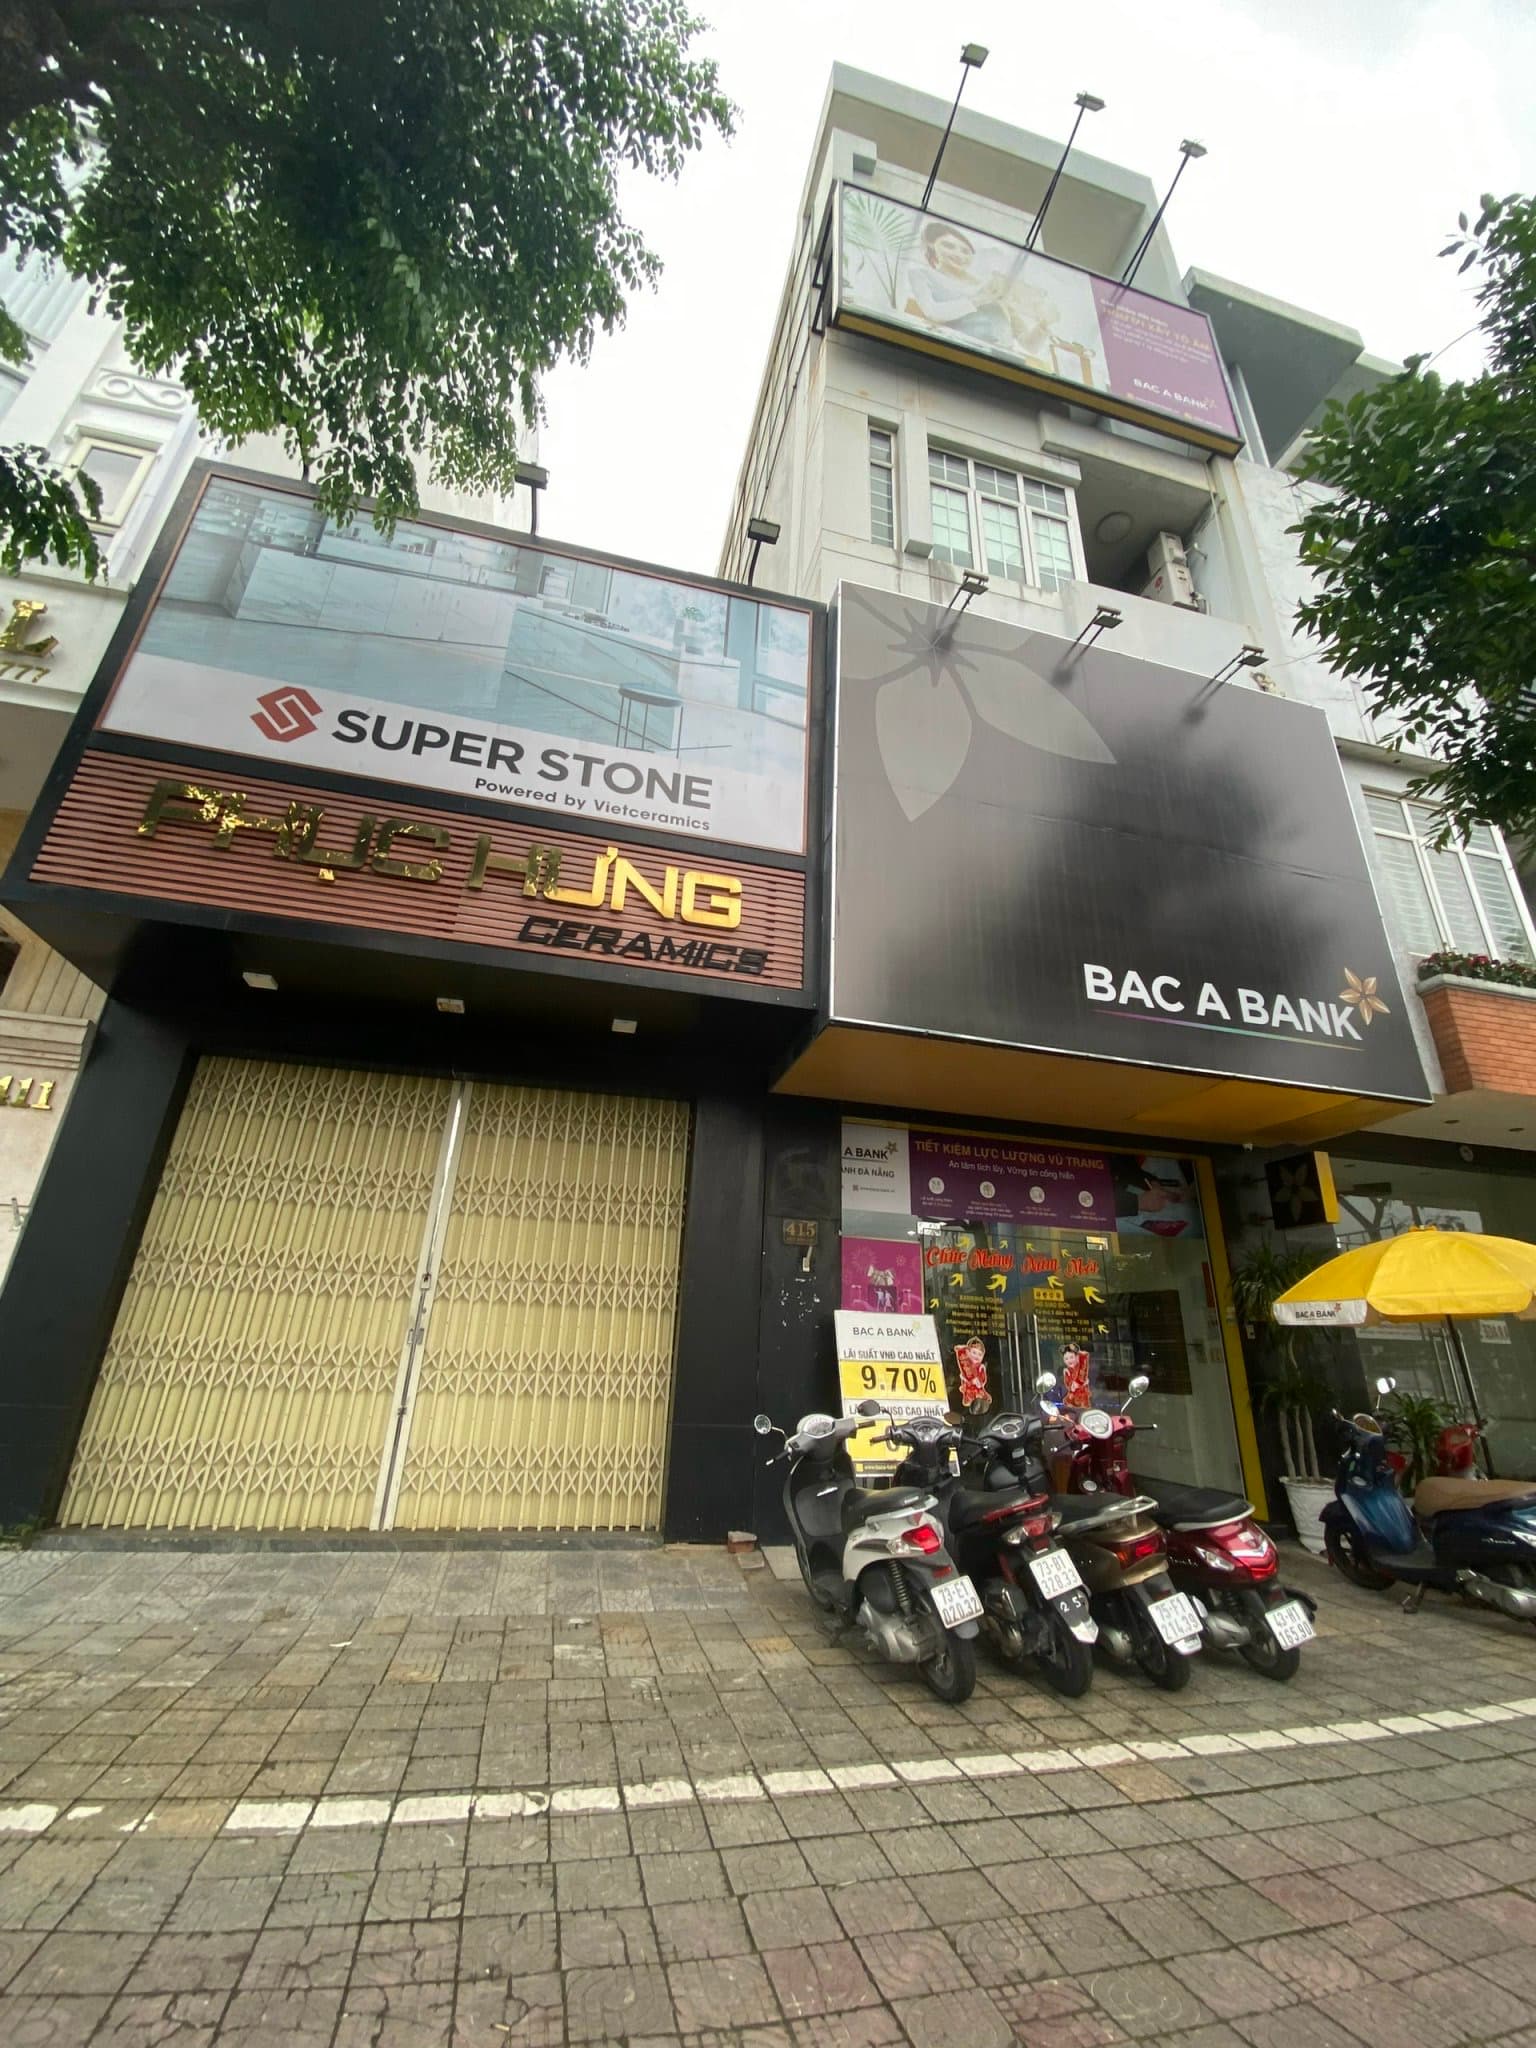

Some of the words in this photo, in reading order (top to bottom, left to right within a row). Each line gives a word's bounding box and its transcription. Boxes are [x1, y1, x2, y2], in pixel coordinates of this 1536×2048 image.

[1133, 378, 1160, 394] BAC
[1163, 388, 1173, 397] A
[1174, 392, 1209, 411] BANK
[332, 709, 525, 775] SUPER
[537, 749, 713, 810] STONE
[475, 777, 557, 803] Powered
[564, 793, 586, 811] by
[594, 799, 711, 832] Vietceramics
[137, 778, 450, 882] PHỤC
[468, 833, 743, 930] HƯNG
[517, 915, 769, 976] CERAMICS
[1083, 963, 1185, 1013] BAC
[1196, 982, 1231, 1020] A
[1237, 988, 1363, 1041] BANK
[844, 1146, 853, 1157] A
[855, 1147, 888, 1160] BANK
[786, 1221, 816, 1237] 415
[853, 1327, 874, 1336] BAC
[887, 1327, 915, 1337] BANK
[897, 1351, 914, 1360] CAO
[861, 1365, 937, 1394] 9.70%
[905, 1406, 920, 1415] CAO
